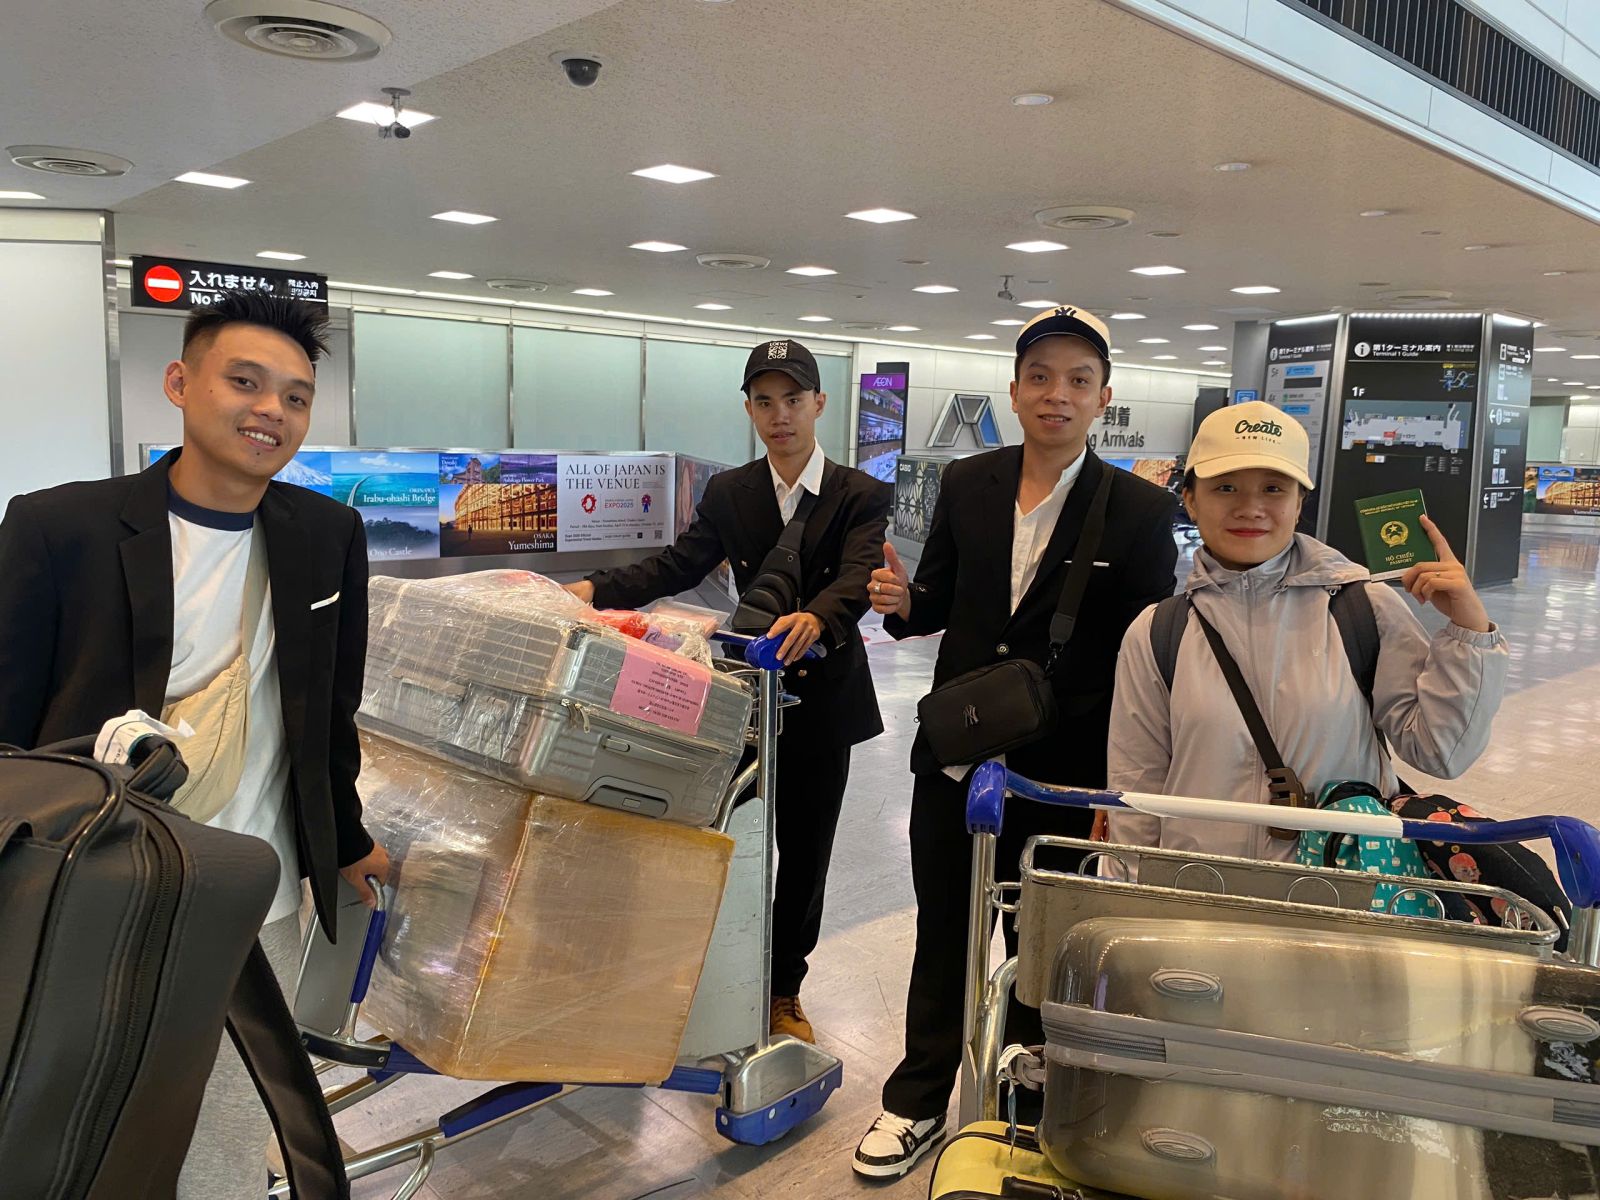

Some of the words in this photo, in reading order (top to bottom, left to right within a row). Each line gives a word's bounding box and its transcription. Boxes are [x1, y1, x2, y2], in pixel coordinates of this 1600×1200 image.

[189, 270, 274, 292] 入れません
[191, 292, 211, 305] No
[1352, 387, 1365, 397] 1F
[1103, 405, 1131, 427] 到着
[1235, 420, 1282, 437] Create
[1101, 430, 1145, 448] Arrivals
[566, 464, 590, 475] ALL
[594, 464, 611, 475] OF
[614, 464, 651, 478] JAPAN
[655, 464, 666, 475] IS
[566, 478, 593, 490] THE
[598, 478, 640, 490] VENUE
[412, 493, 436, 504] Bridge
[389, 546, 412, 556] Castle
[508, 540, 554, 550] Yumeshima
